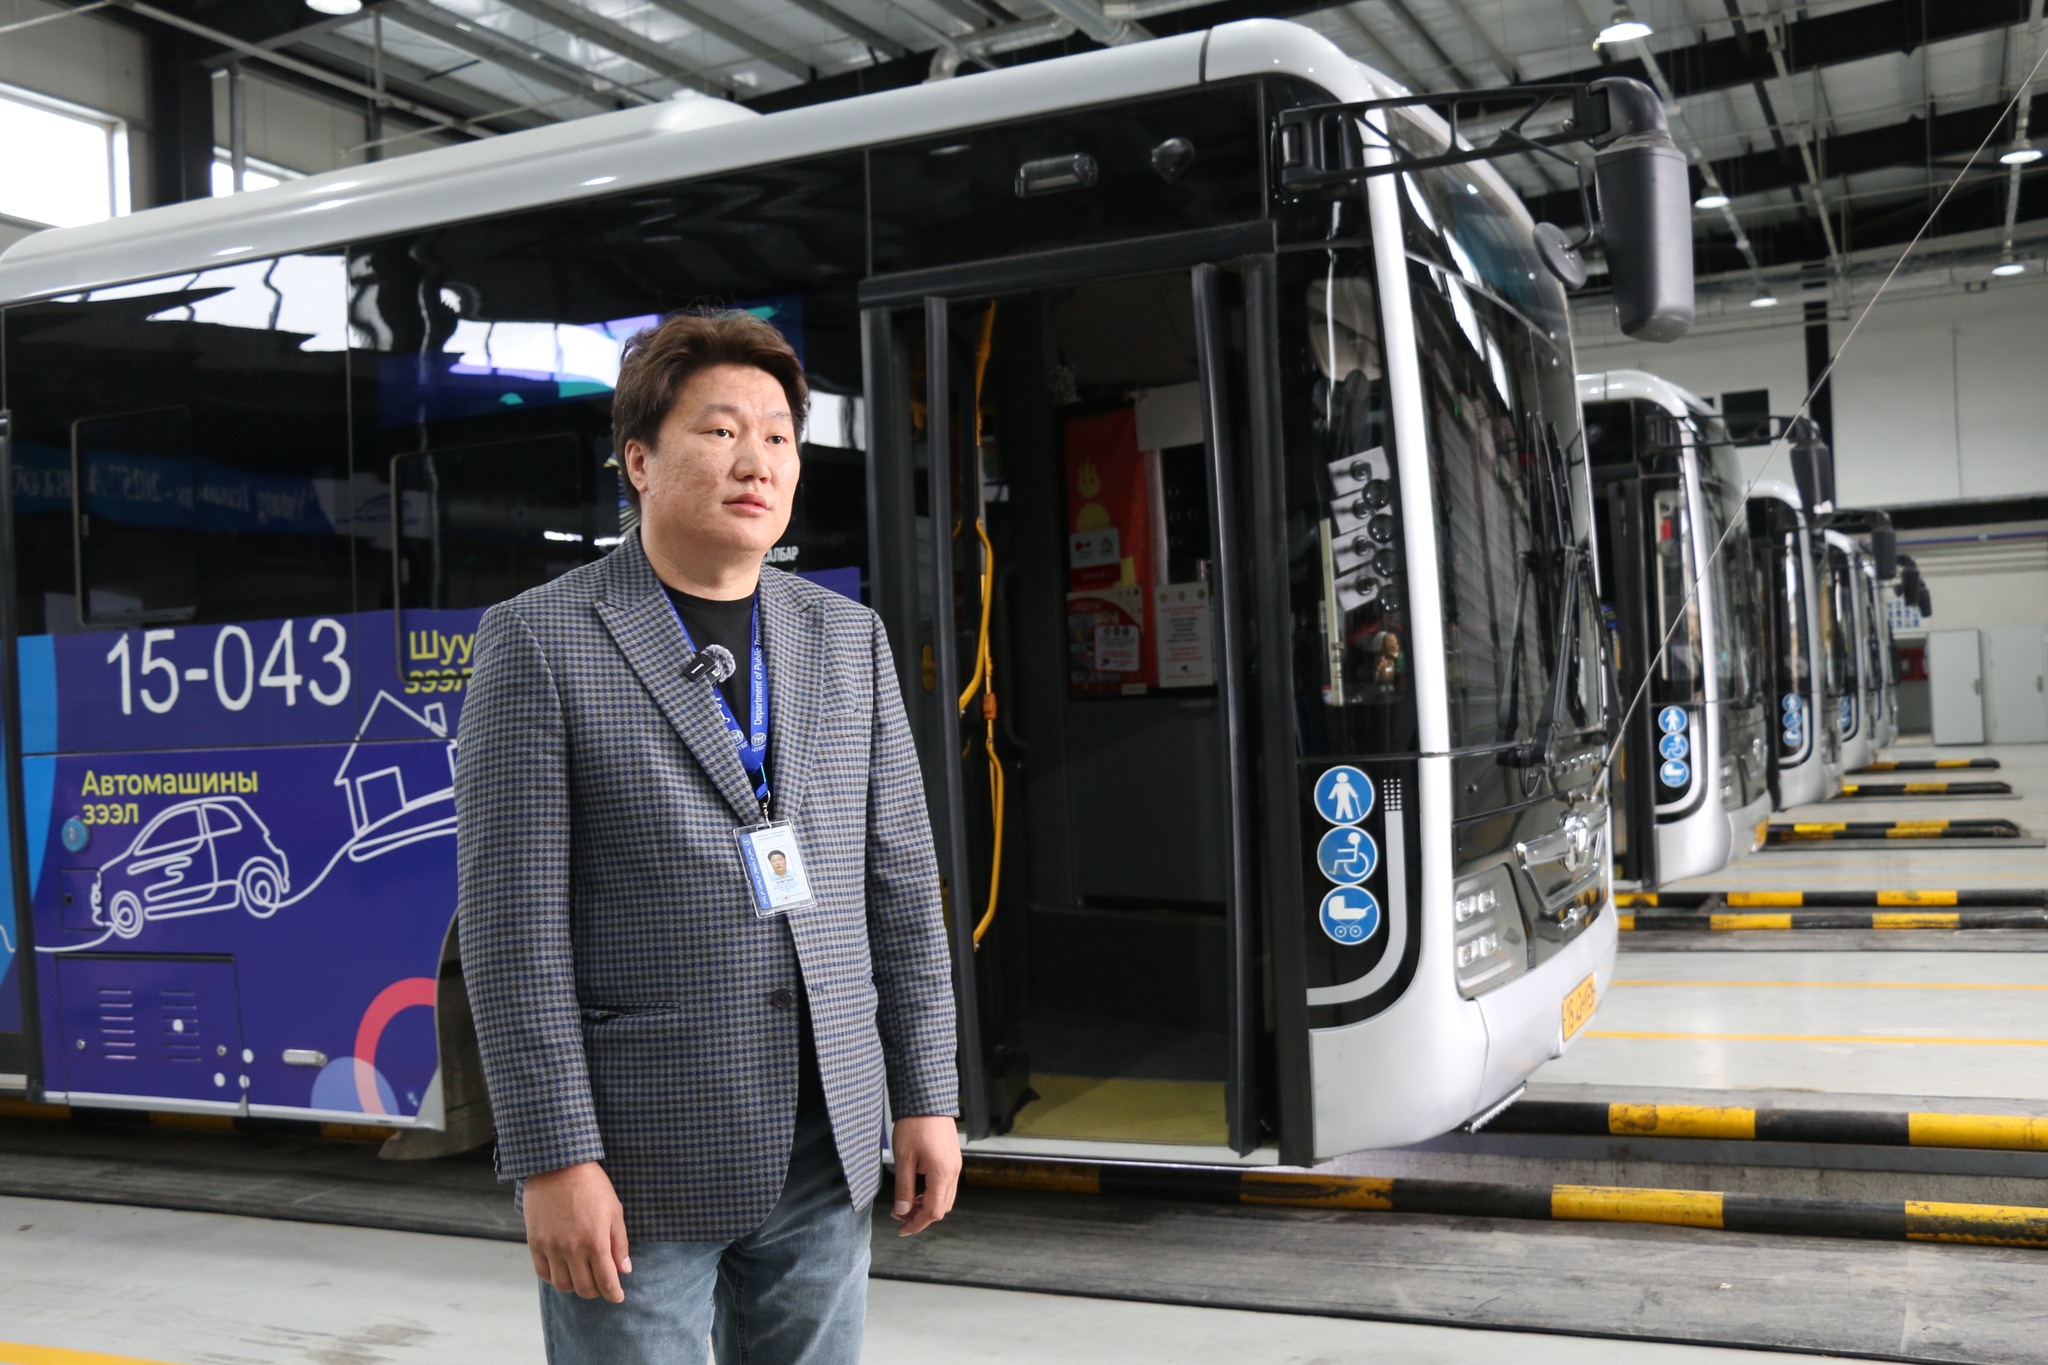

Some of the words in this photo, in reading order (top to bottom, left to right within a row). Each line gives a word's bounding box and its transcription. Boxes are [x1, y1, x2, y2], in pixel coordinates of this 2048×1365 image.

[763, 545, 799, 563] АЛБАР
[106, 617, 351, 715] 15-043
[753, 647, 763, 671] Public
[753, 671, 763, 680] of
[753, 681, 765, 725] Department
[736, 740, 748, 751] ТБГ
[81, 769, 258, 797] Автомашины
[82, 803, 139, 825] зээл
